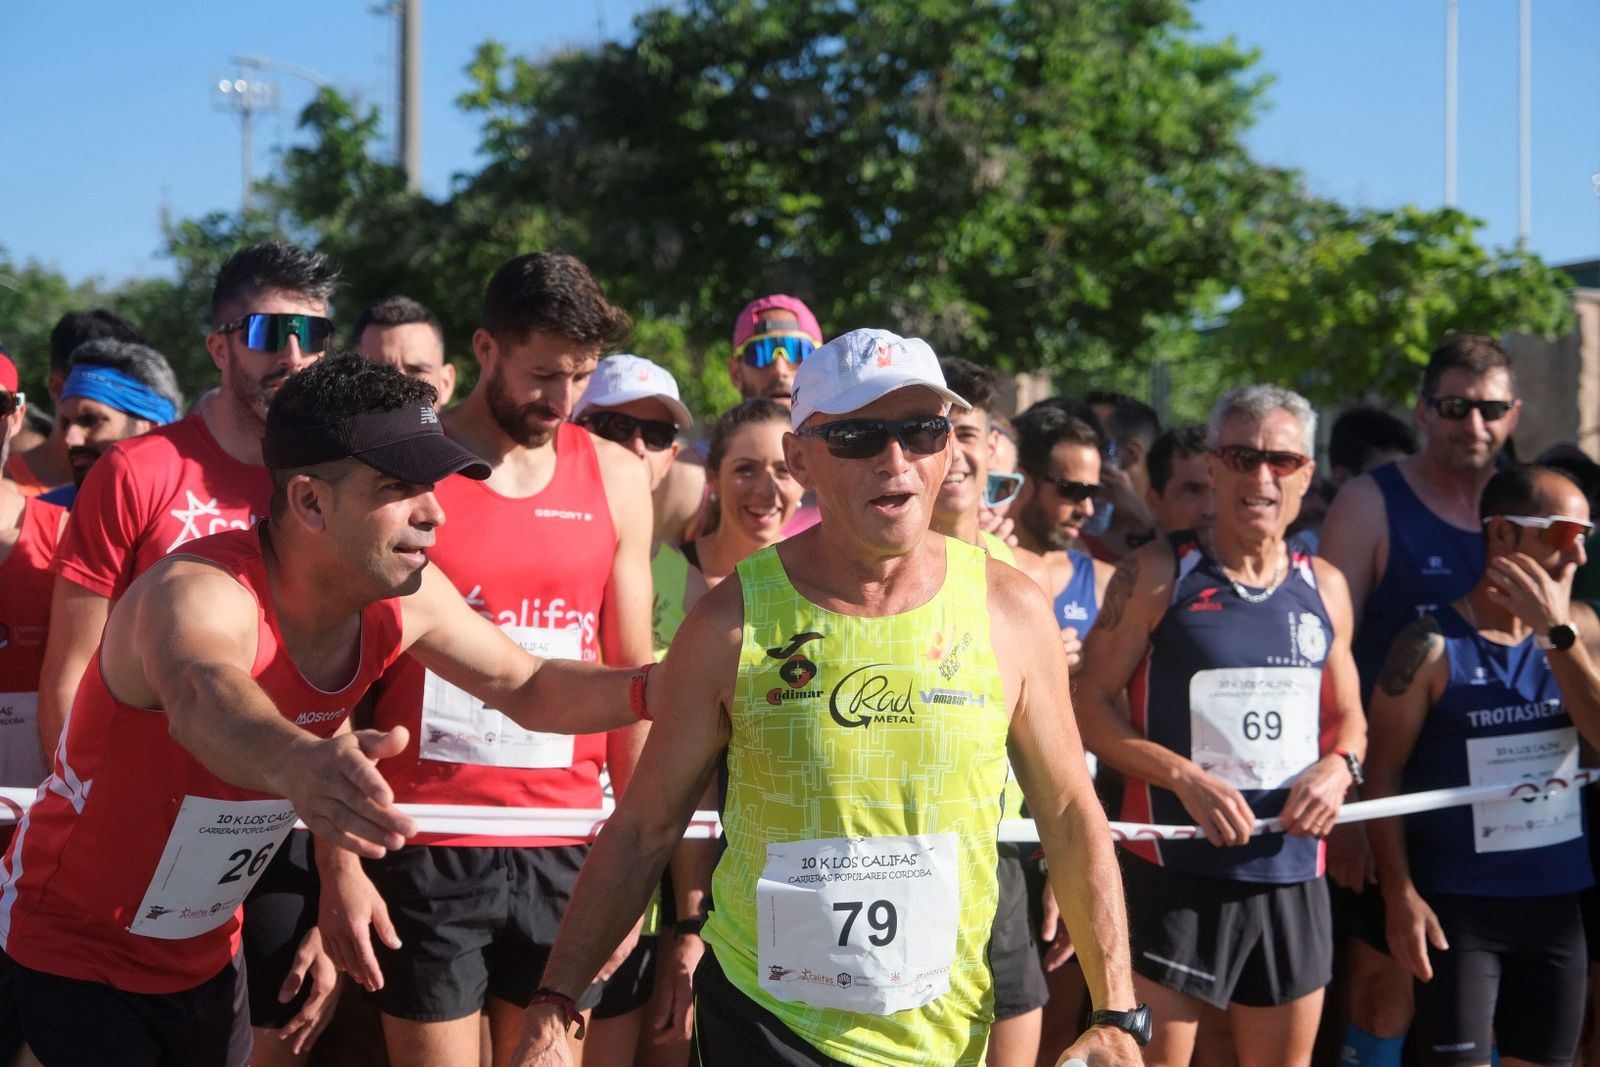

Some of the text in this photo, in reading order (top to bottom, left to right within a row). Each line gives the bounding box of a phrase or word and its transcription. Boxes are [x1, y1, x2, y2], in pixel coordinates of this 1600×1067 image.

[849, 672, 915, 715] Rad
[873, 715, 916, 724] METAL
[1243, 711, 1283, 741] 69
[217, 814, 233, 824] 10
[233, 815, 242, 825] K
[244, 815, 266, 825] LOS
[199, 827, 240, 835] CARRERAS
[217, 842, 275, 885] 26
[801, 853, 918, 869] 10 K LOS CALIFAS
[788, 868, 933, 884] CARRERAS POPULARES CORDOBA
[832, 899, 898, 948] 79
